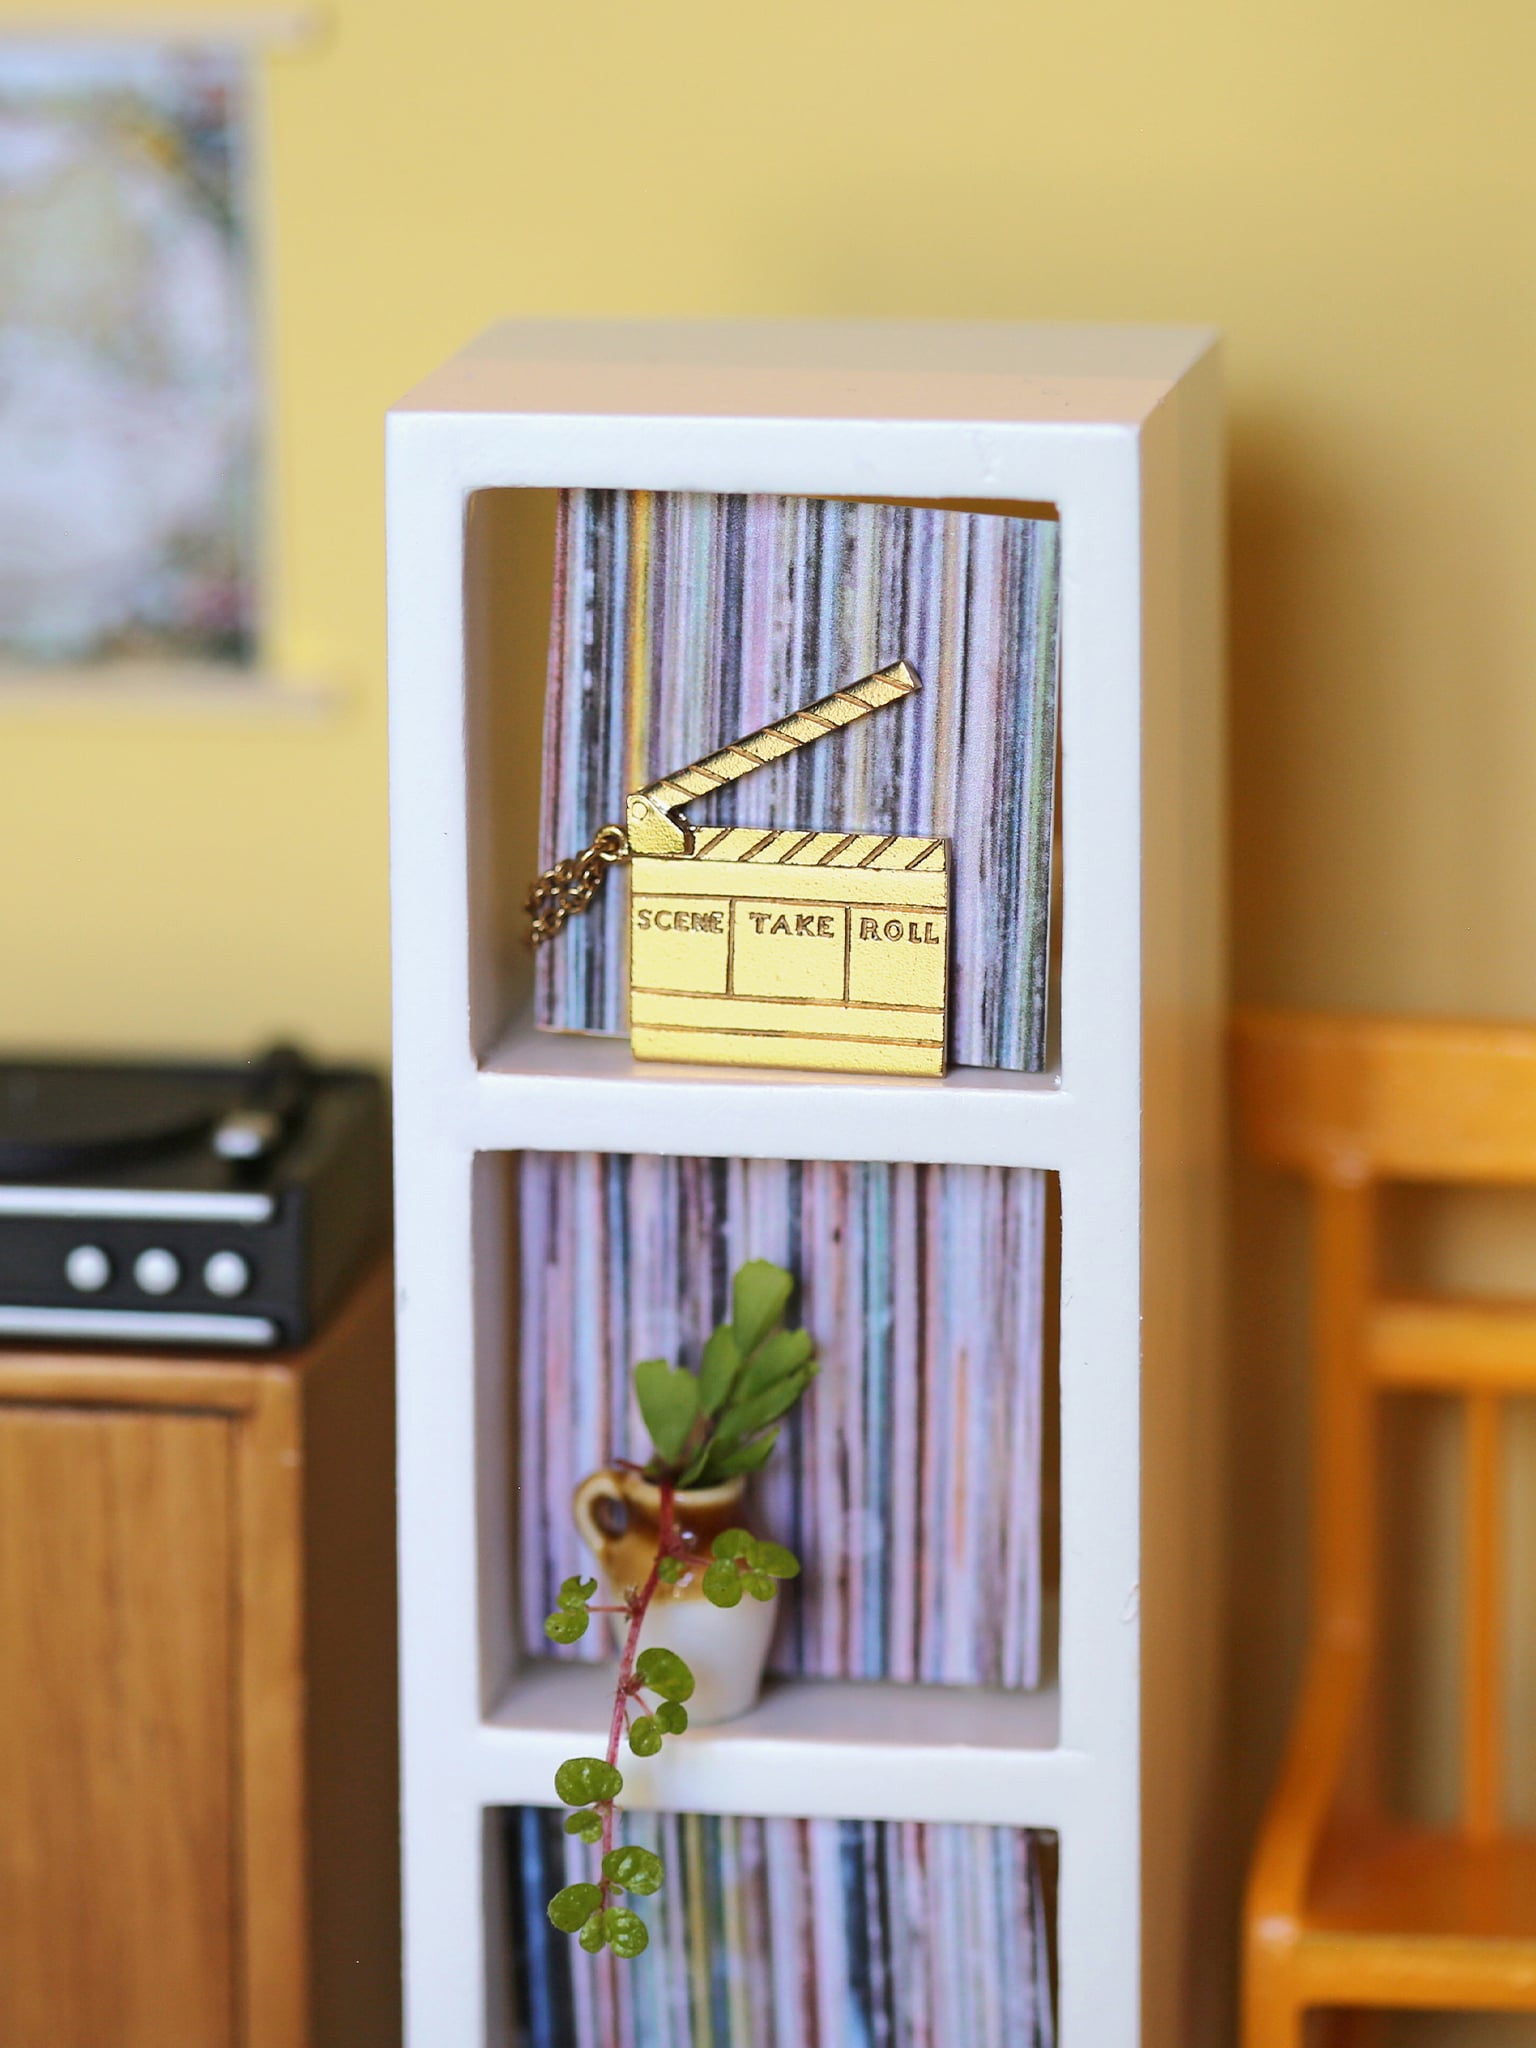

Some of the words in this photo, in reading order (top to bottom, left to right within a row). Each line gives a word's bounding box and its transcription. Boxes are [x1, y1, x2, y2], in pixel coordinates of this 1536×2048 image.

[637, 909, 724, 934] SCENE
[749, 911, 835, 939] TAKE
[859, 917, 939, 945] ROLL
